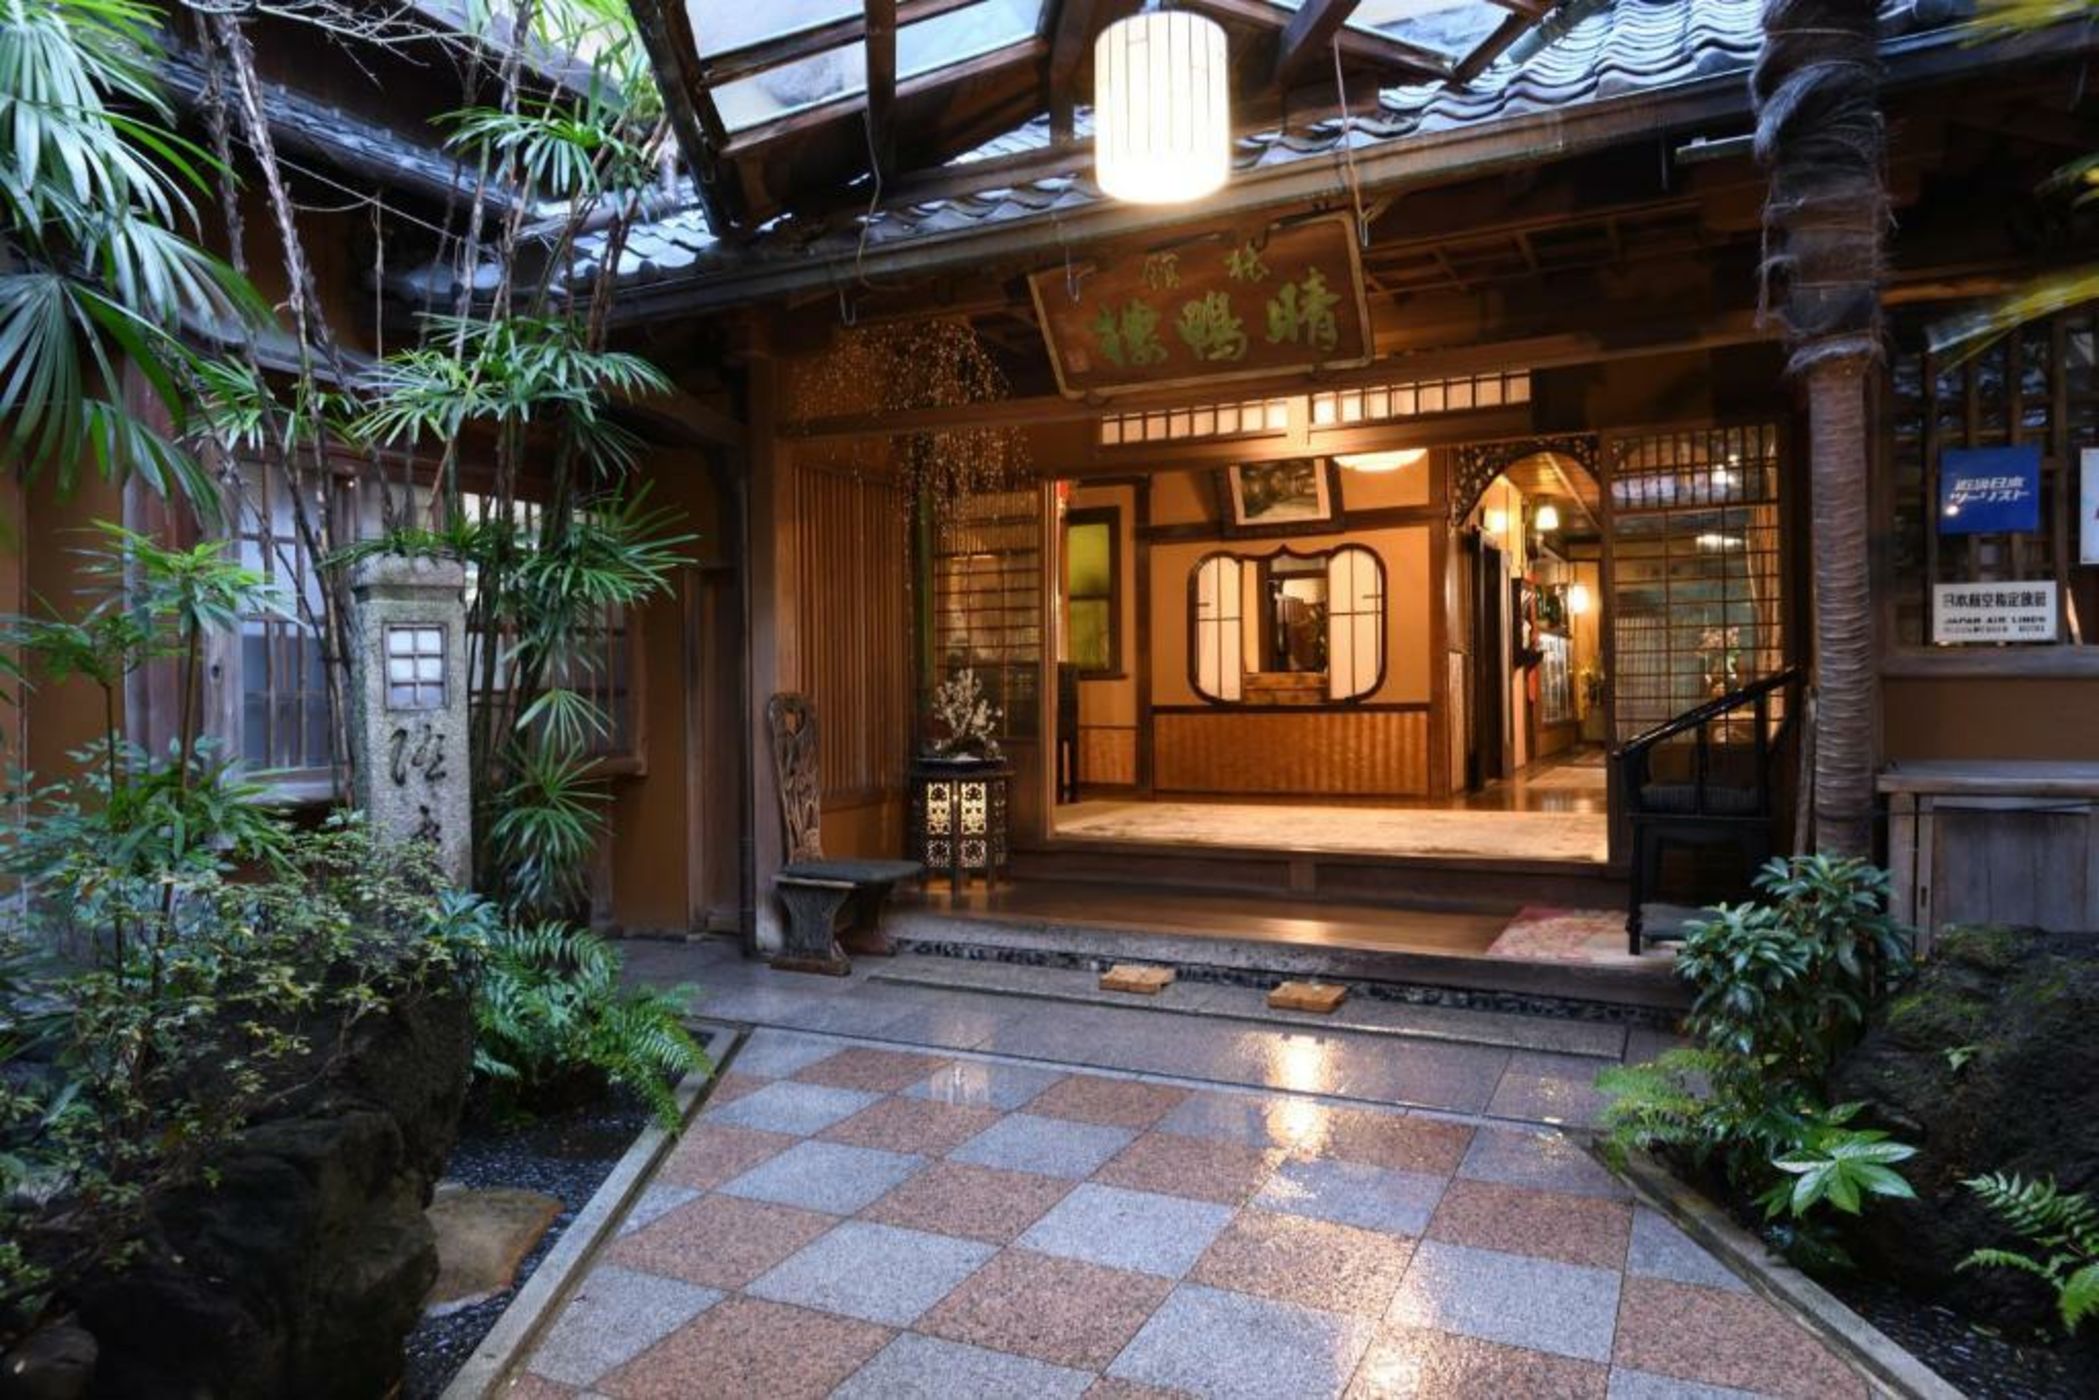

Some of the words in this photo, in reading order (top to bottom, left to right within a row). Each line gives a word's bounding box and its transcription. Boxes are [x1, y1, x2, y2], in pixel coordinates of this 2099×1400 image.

[1950, 489, 2030, 504] ツーリスト
[1945, 617, 1982, 625] JAPAN
[1986, 616, 2006, 624] AIR
